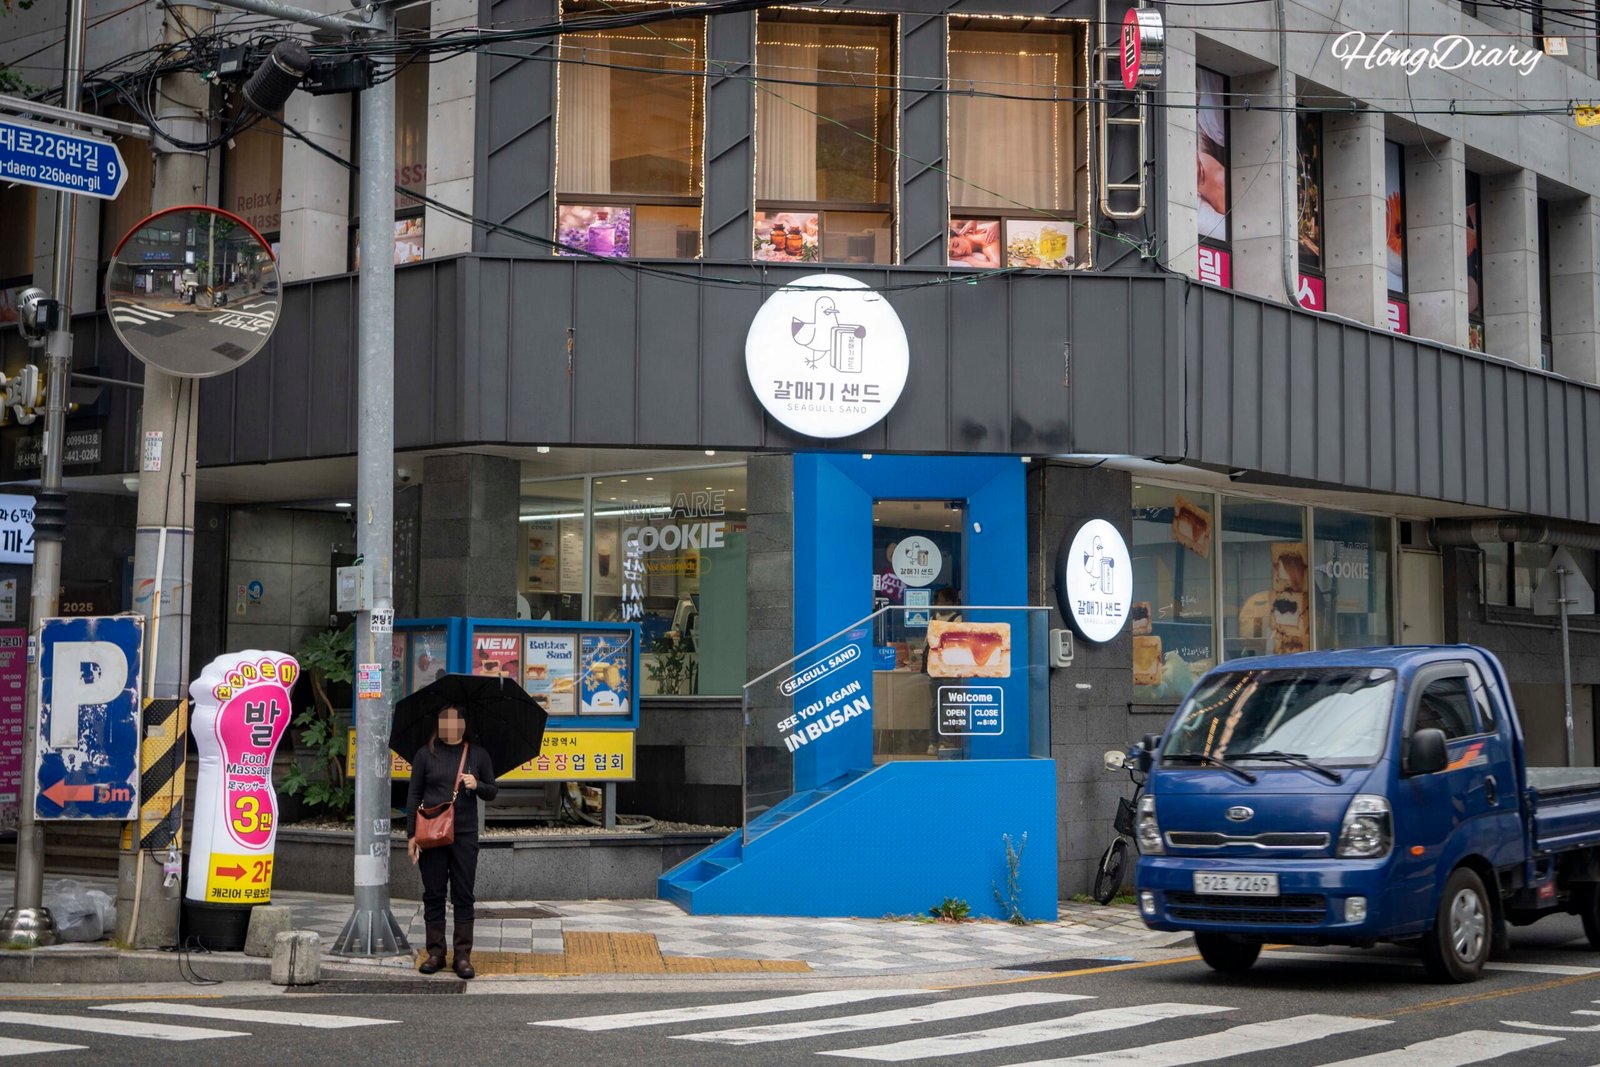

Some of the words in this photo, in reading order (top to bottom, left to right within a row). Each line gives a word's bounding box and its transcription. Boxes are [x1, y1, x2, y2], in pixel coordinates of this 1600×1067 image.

[40, 165, 101, 191] 226beon-gil
[107, 162, 116, 180] 9
[237, 193, 271, 211] Relax
[773, 380, 835, 401] 갈매기
[841, 383, 881, 403] 샌드
[787, 403, 835, 413] SEAGULL
[839, 405, 867, 414] SAND
[63, 448, 98, 463] -441-0284
[669, 490, 726, 519] ARE
[622, 522, 725, 553] COOKIE
[900, 568, 920, 576] 갈매기
[921, 568, 934, 576] 샌드
[1326, 561, 1369, 580] COOKIE
[63, 602, 93, 613] 2025
[1078, 600, 1103, 616] 갈매기
[1105, 602, 1122, 617] 샌드
[476, 638, 517, 650] NEW
[529, 640, 568, 650] Butter
[546, 650, 572, 659] Sand
[784, 664, 829, 693] SEAGULL
[828, 648, 856, 668] SAND
[51, 641, 128, 748] P
[948, 692, 993, 702] Welcome
[777, 714, 799, 733] SEE
[798, 700, 824, 720] YOU
[825, 680, 861, 707] AGAIN
[946, 709, 966, 717] OPEN
[974, 709, 999, 717] CLOSE
[245, 699, 281, 747] 발
[783, 729, 809, 753] IN
[805, 695, 872, 741] BUSAN
[241, 753, 266, 764] Foot
[594, 754, 624, 771] 협회
[226, 763, 271, 777] Massage
[233, 796, 273, 833] 3만
[251, 860, 272, 883] 2F
[1235, 876, 1270, 891] 2269
[212, 888, 242, 899] 캐리어
